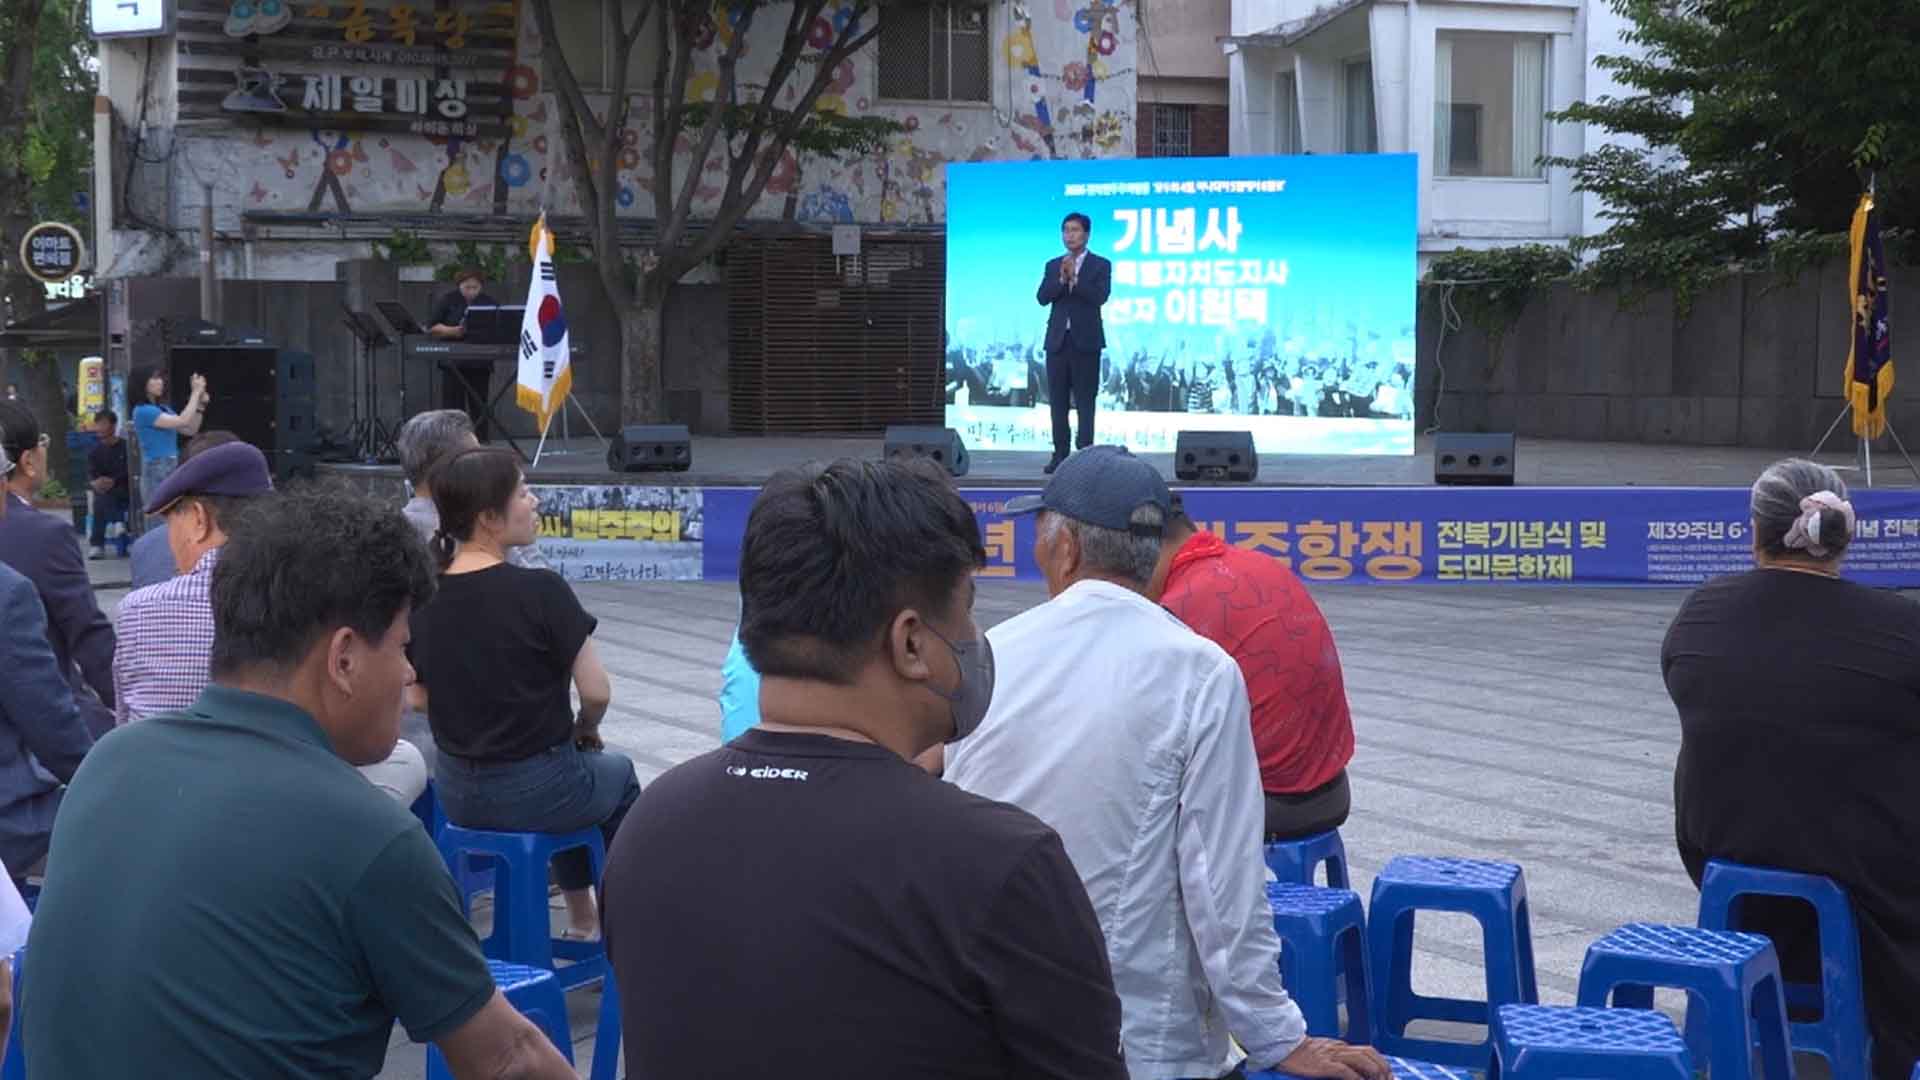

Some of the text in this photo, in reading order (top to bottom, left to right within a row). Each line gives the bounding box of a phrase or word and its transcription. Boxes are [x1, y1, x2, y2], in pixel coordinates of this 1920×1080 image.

[1113, 206, 1243, 253] 기념사
[1115, 259, 1289, 287] 특별자치도지사
[1107, 287, 1268, 326] 선자 이원택
[572, 508, 681, 541] 민주주의
[1437, 521, 1606, 549] 전북기념식 및
[1648, 521, 1723, 540] 제39주년
[971, 520, 1424, 580] 년 주항쟁
[1437, 554, 1574, 580] 도민문화제
